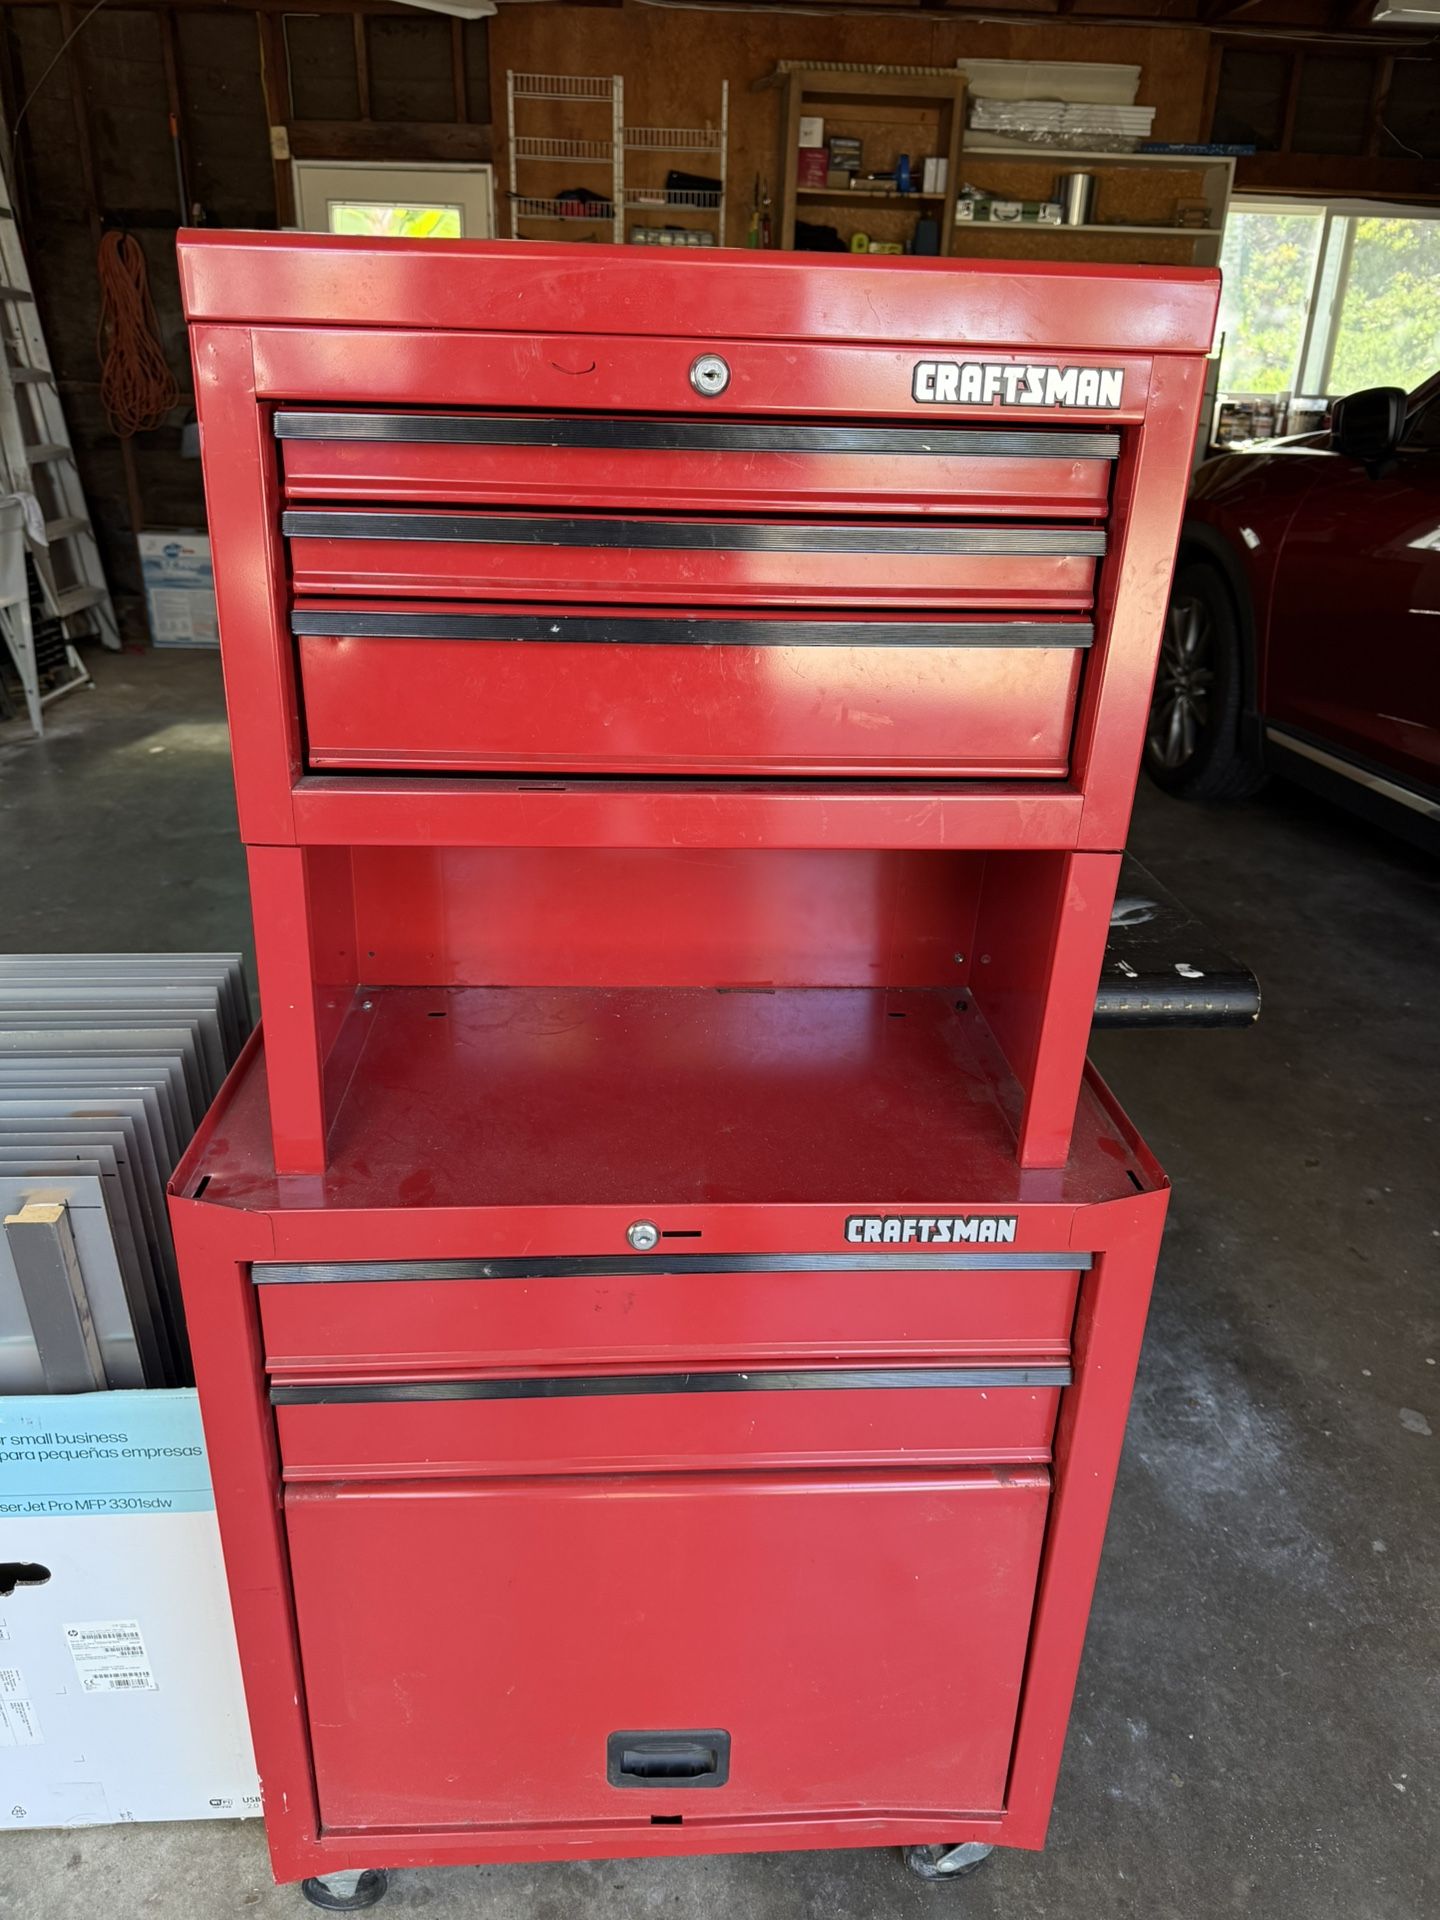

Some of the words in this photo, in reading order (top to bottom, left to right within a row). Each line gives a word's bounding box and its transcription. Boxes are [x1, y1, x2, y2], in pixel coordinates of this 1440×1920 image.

[914, 362, 1124, 409] CRAFTSMAN
[846, 1217, 1017, 1243] CRAFTSMAN
[10, 1433, 53, 1446] small
[55, 1432, 128, 1445] business
[0, 1450, 36, 1463] para
[38, 1447, 119, 1462] pequeñas
[121, 1446, 203, 1460] empresas
[48, 1500, 73, 1511] Pro
[74, 1499, 107, 1510] MFP
[109, 1497, 173, 1509] 3301sdw
